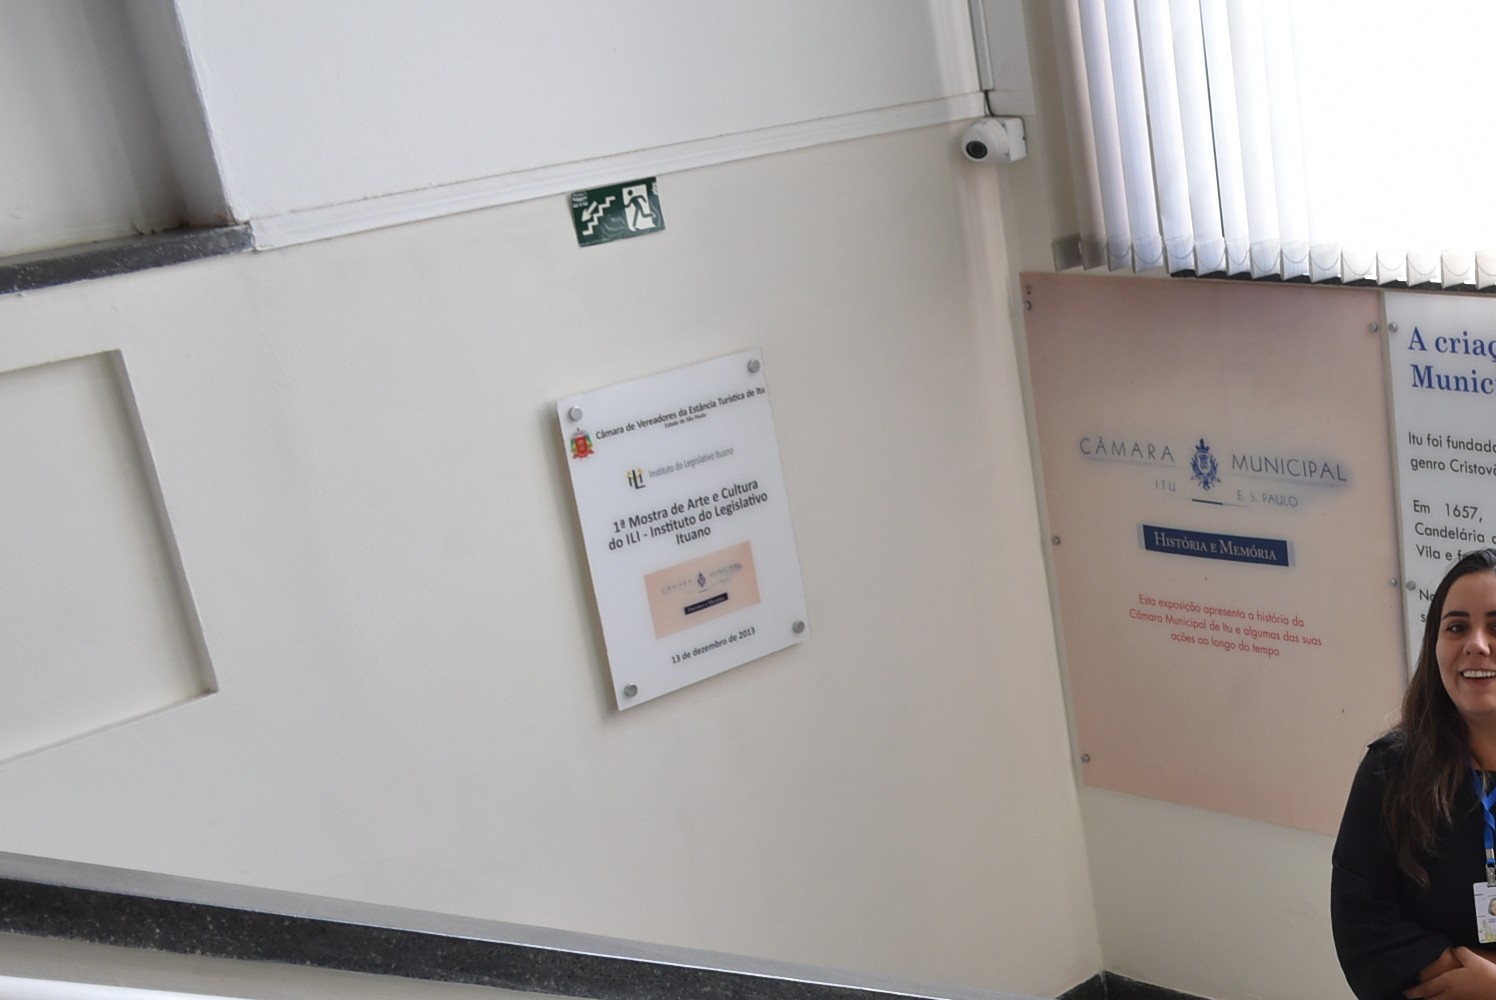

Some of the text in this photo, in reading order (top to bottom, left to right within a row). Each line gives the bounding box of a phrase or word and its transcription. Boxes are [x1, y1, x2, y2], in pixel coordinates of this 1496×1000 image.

[1407, 326, 1427, 351] A
[1408, 431, 1423, 446] Itu
[1426, 432, 1442, 448] foi
[1078, 435, 1347, 482] CÂMARA MUNICIPAL
[1409, 457, 1445, 471] genro
[627, 508, 668, 528] Mostra
[670, 502, 684, 515] de
[686, 495, 710, 510] Arte
[711, 492, 719, 502] e
[720, 480, 758, 499] Cultura
[1412, 498, 1430, 514] Em
[1444, 502, 1482, 523] 1657,
[608, 537, 623, 550] do
[625, 530, 640, 545] ILI
[649, 515, 696, 537] Instituto
[697, 508, 712, 522] do
[713, 492, 768, 517] Legislativo
[1414, 521, 1485, 543] Candelária
[675, 526, 711, 544] Ituano
[1415, 543, 1440, 559] Vila
[1444, 551, 1452, 561] e
[1138, 593, 1304, 627] Esta exposição apresenta a história da
[1128, 607, 1322, 646] Câmara Municipal de Itu e algumas das suas
[671, 626, 755, 664] 13 de dezembro de 2013
[1170, 631, 1280, 658] ações ao longo do tempo
